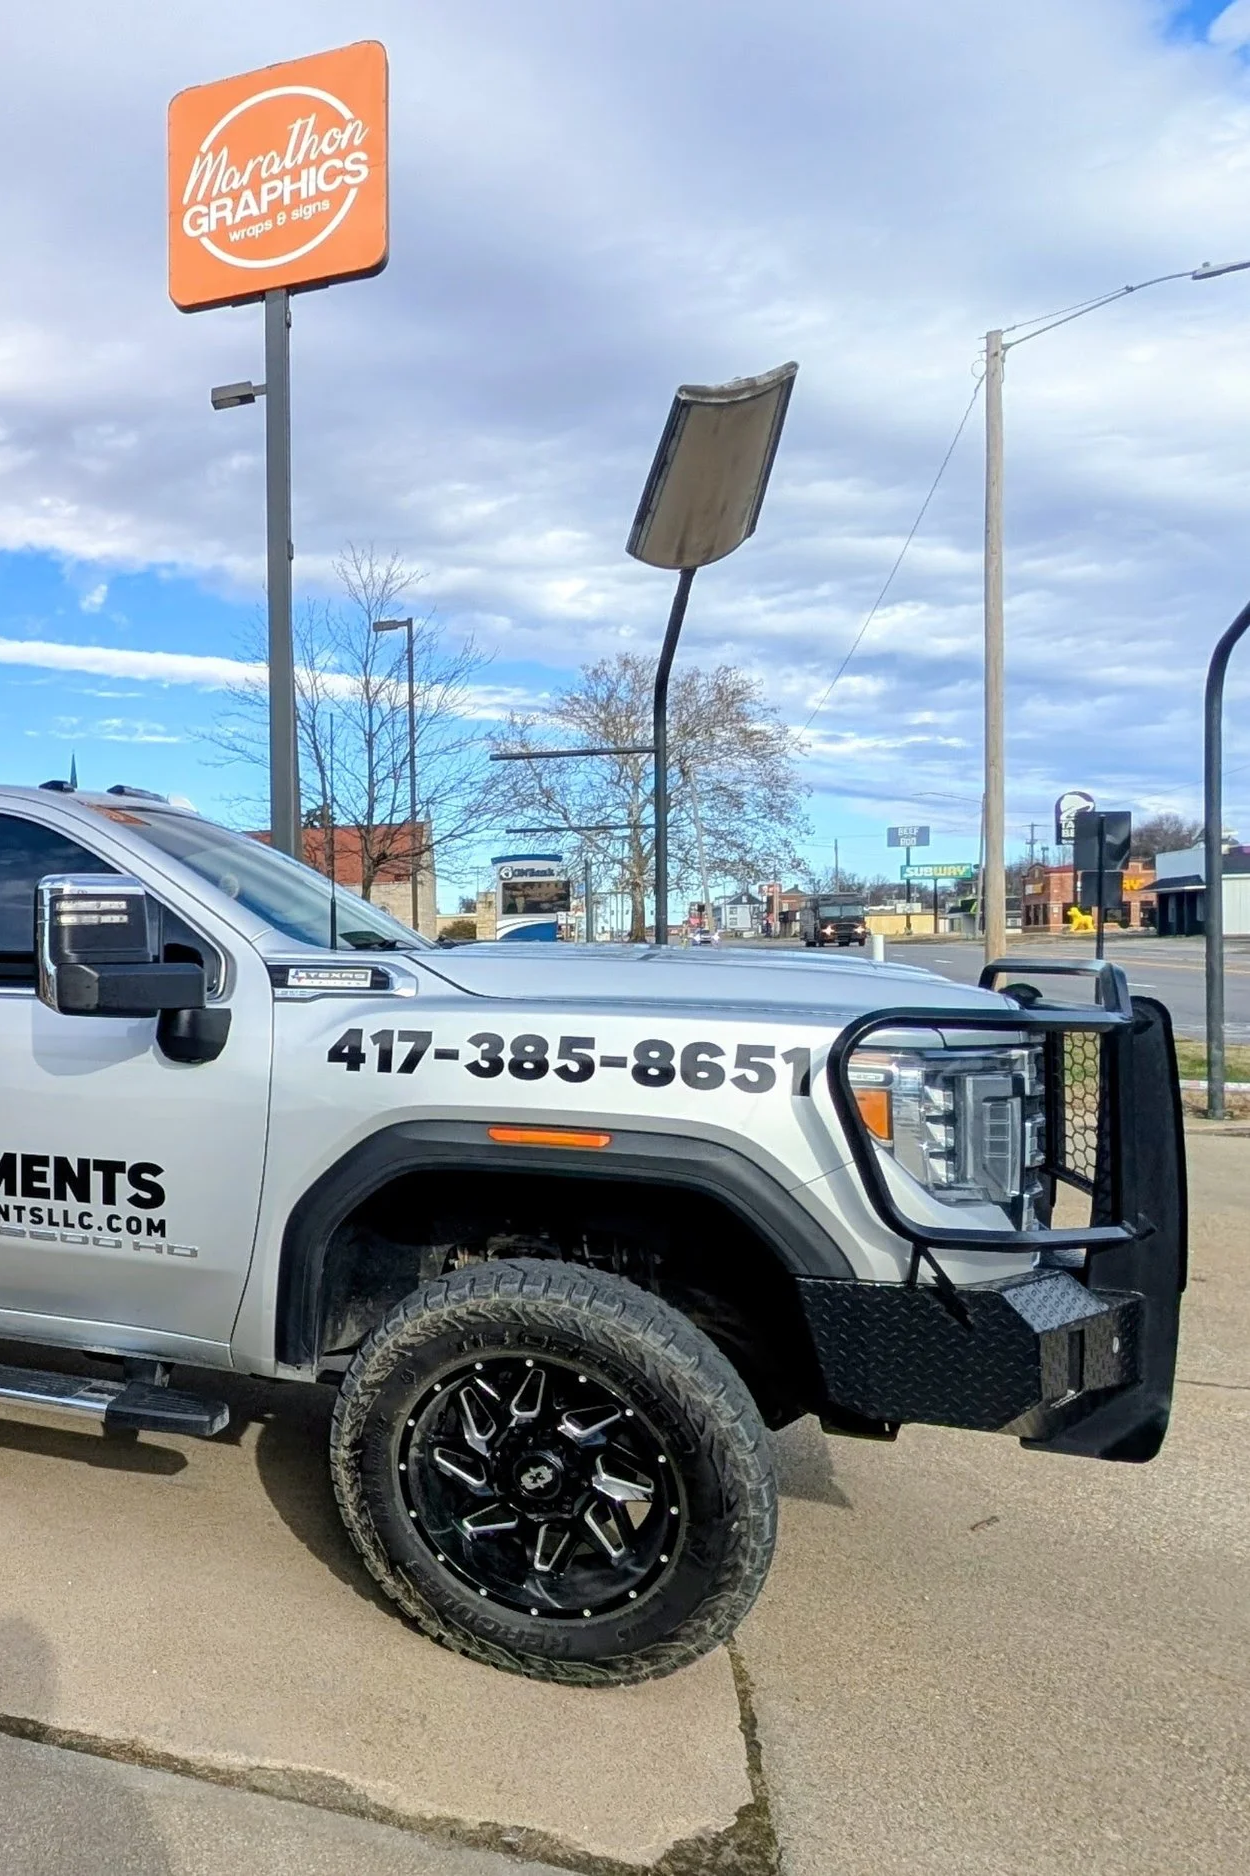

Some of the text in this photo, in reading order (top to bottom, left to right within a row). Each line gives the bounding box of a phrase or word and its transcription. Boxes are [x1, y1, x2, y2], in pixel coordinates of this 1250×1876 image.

[182, 113, 370, 206] Marathon
[182, 152, 370, 239] GRAPHICS
[229, 199, 331, 243] wraps & signs
[1061, 820, 1075, 829] TA
[903, 865, 966, 877] SUBWAY
[309, 971, 367, 980] TEXAS
[327, 1028, 812, 1097] 417-385-8651
[133, 1239, 199, 1258] HD
